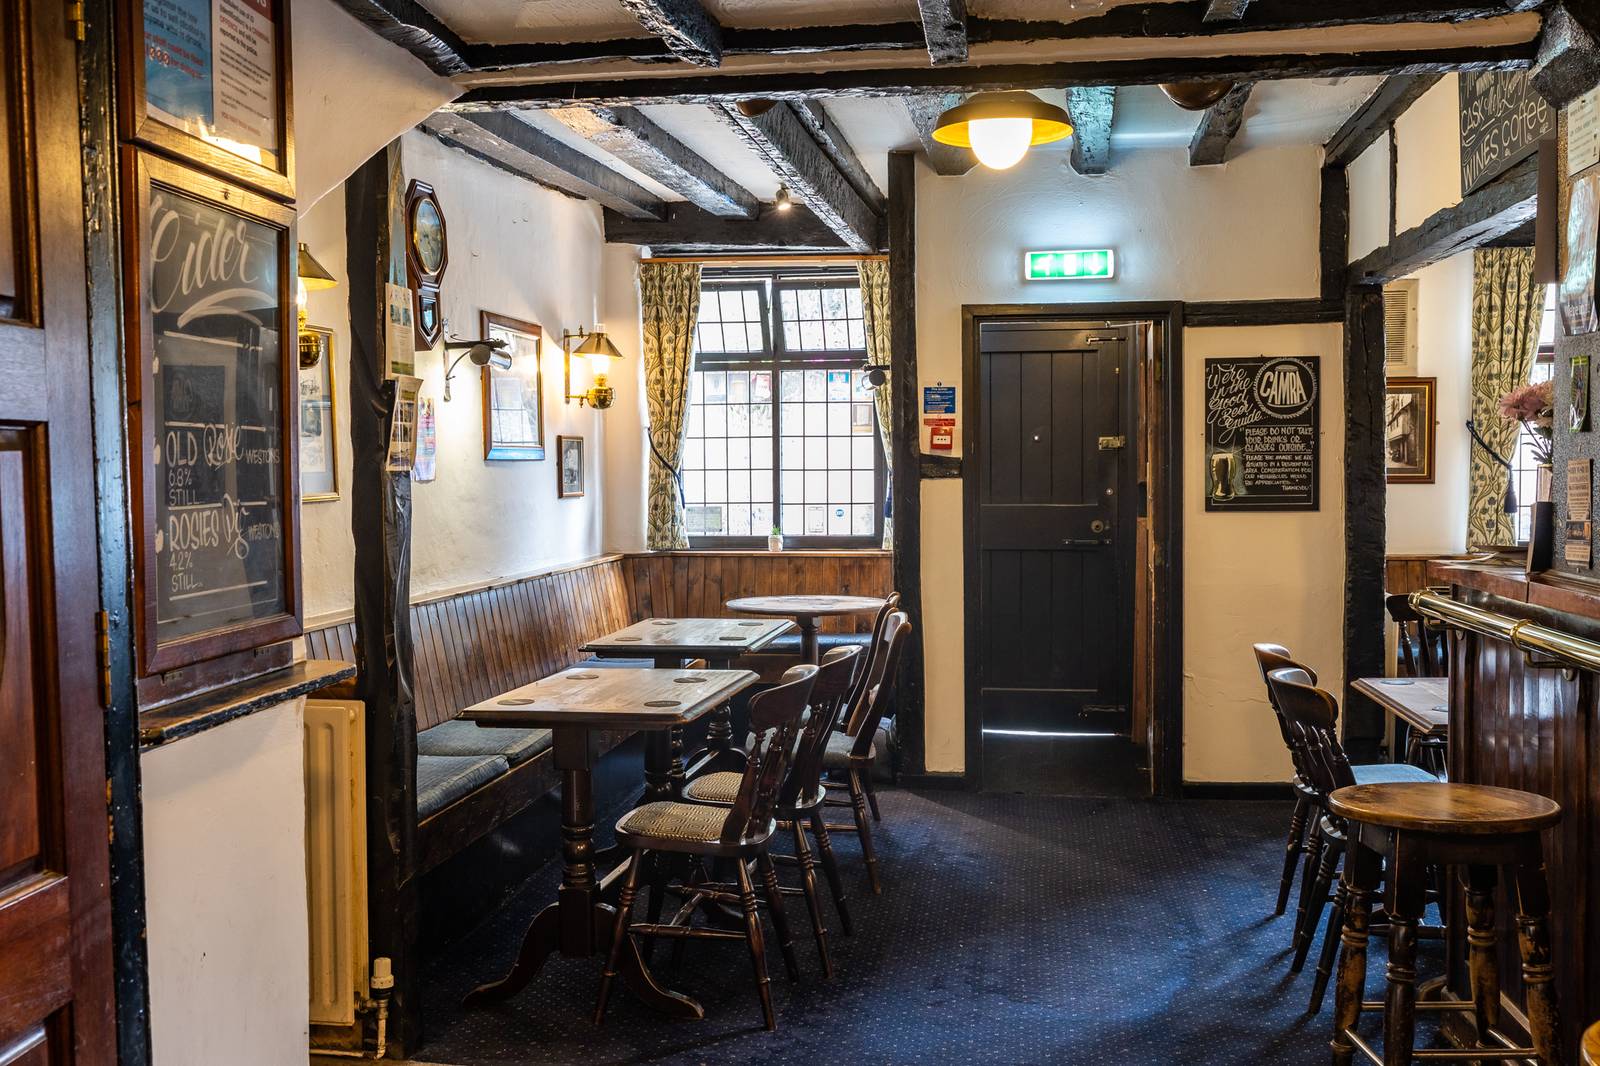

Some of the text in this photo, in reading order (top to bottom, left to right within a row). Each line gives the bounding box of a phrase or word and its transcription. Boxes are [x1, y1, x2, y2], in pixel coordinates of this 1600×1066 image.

[1461, 96, 1485, 136] CASK
[1463, 129, 1499, 190] WINES
[150, 194, 259, 313] Cider
[1229, 378, 1253, 394] the
[1259, 370, 1308, 405] CAMRA
[1269, 427, 1280, 435] DO
[1281, 427, 1296, 435] NOT
[1296, 427, 1313, 435] TAKE
[1290, 435, 1302, 443] OR
[166, 431, 198, 467] OLD
[245, 447, 281, 465] WESTONS
[168, 468, 193, 487] 6.8%
[169, 510, 220, 552] ROSIES
[168, 551, 193, 571] 4.2%
